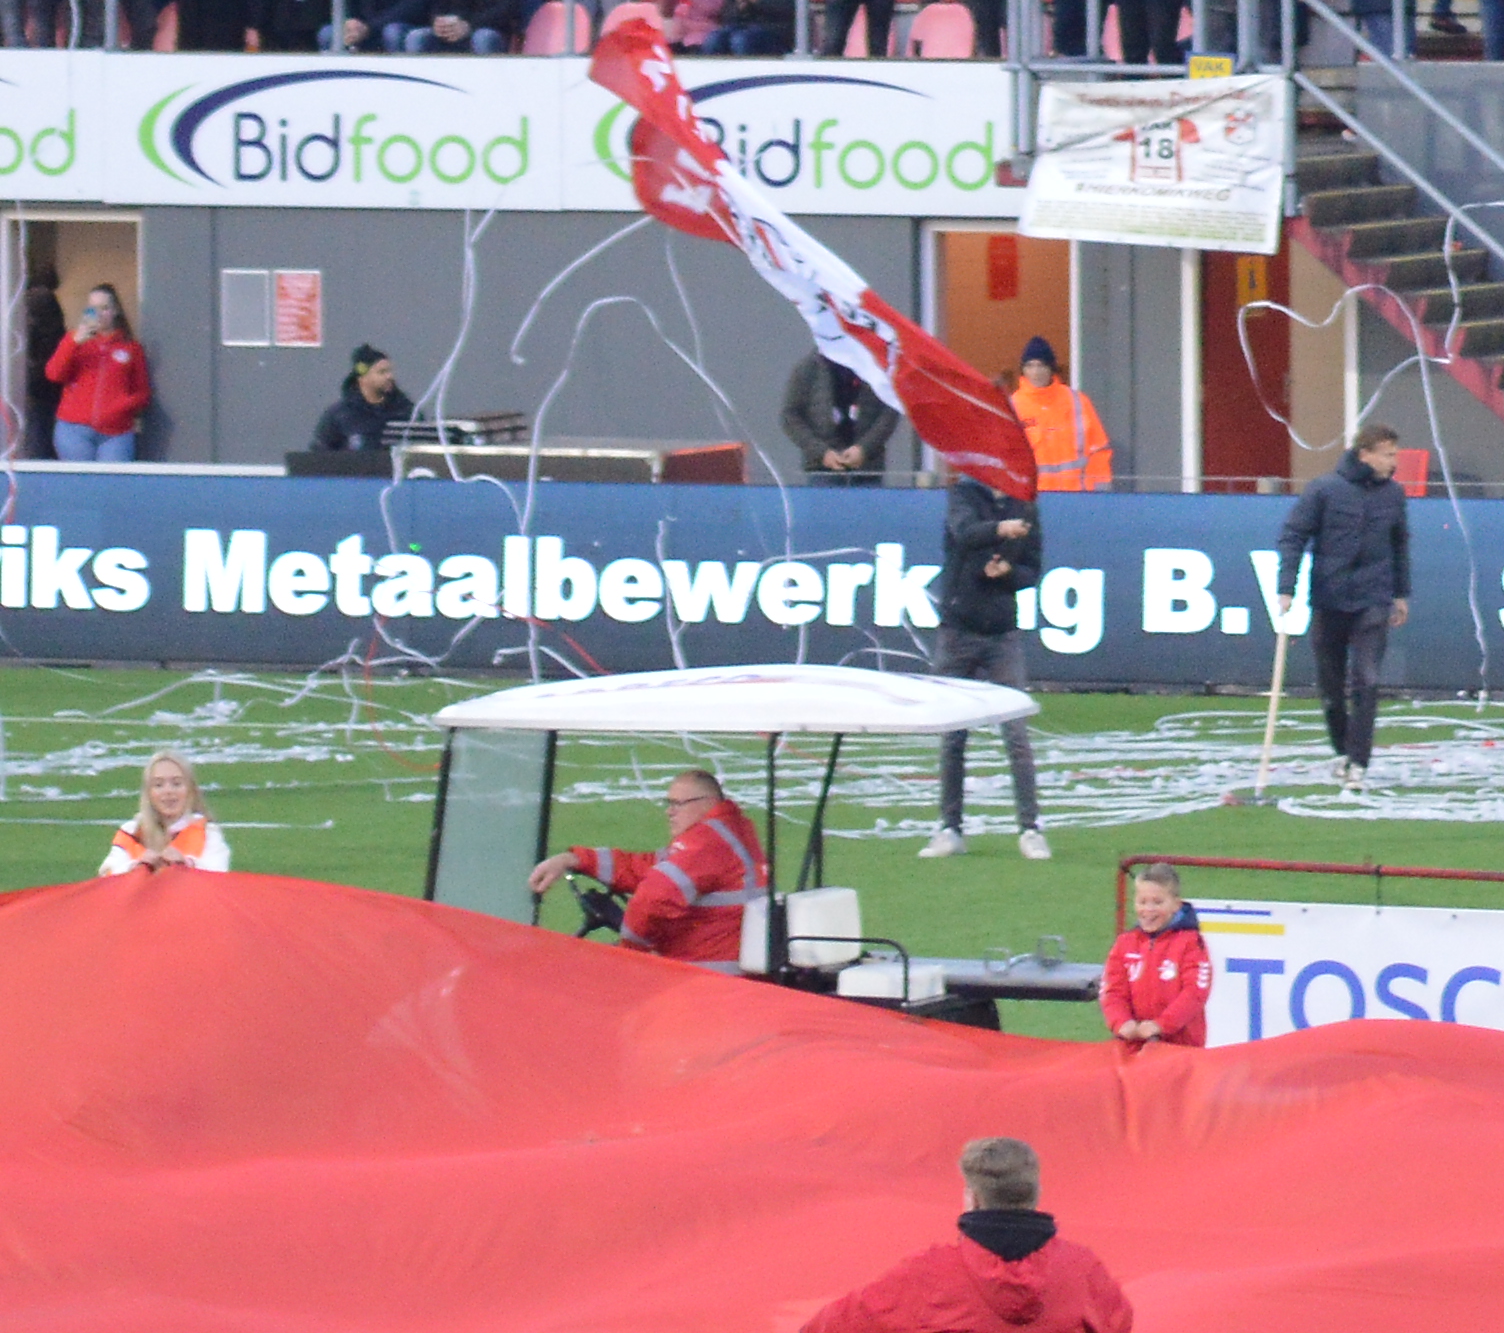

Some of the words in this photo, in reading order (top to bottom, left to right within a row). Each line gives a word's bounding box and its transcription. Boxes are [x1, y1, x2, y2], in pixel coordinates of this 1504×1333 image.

[233, 112, 528, 185] Bidfood
[1139, 138, 1174, 160] 18
[185, 529, 1104, 653] Metaalbewerkg
